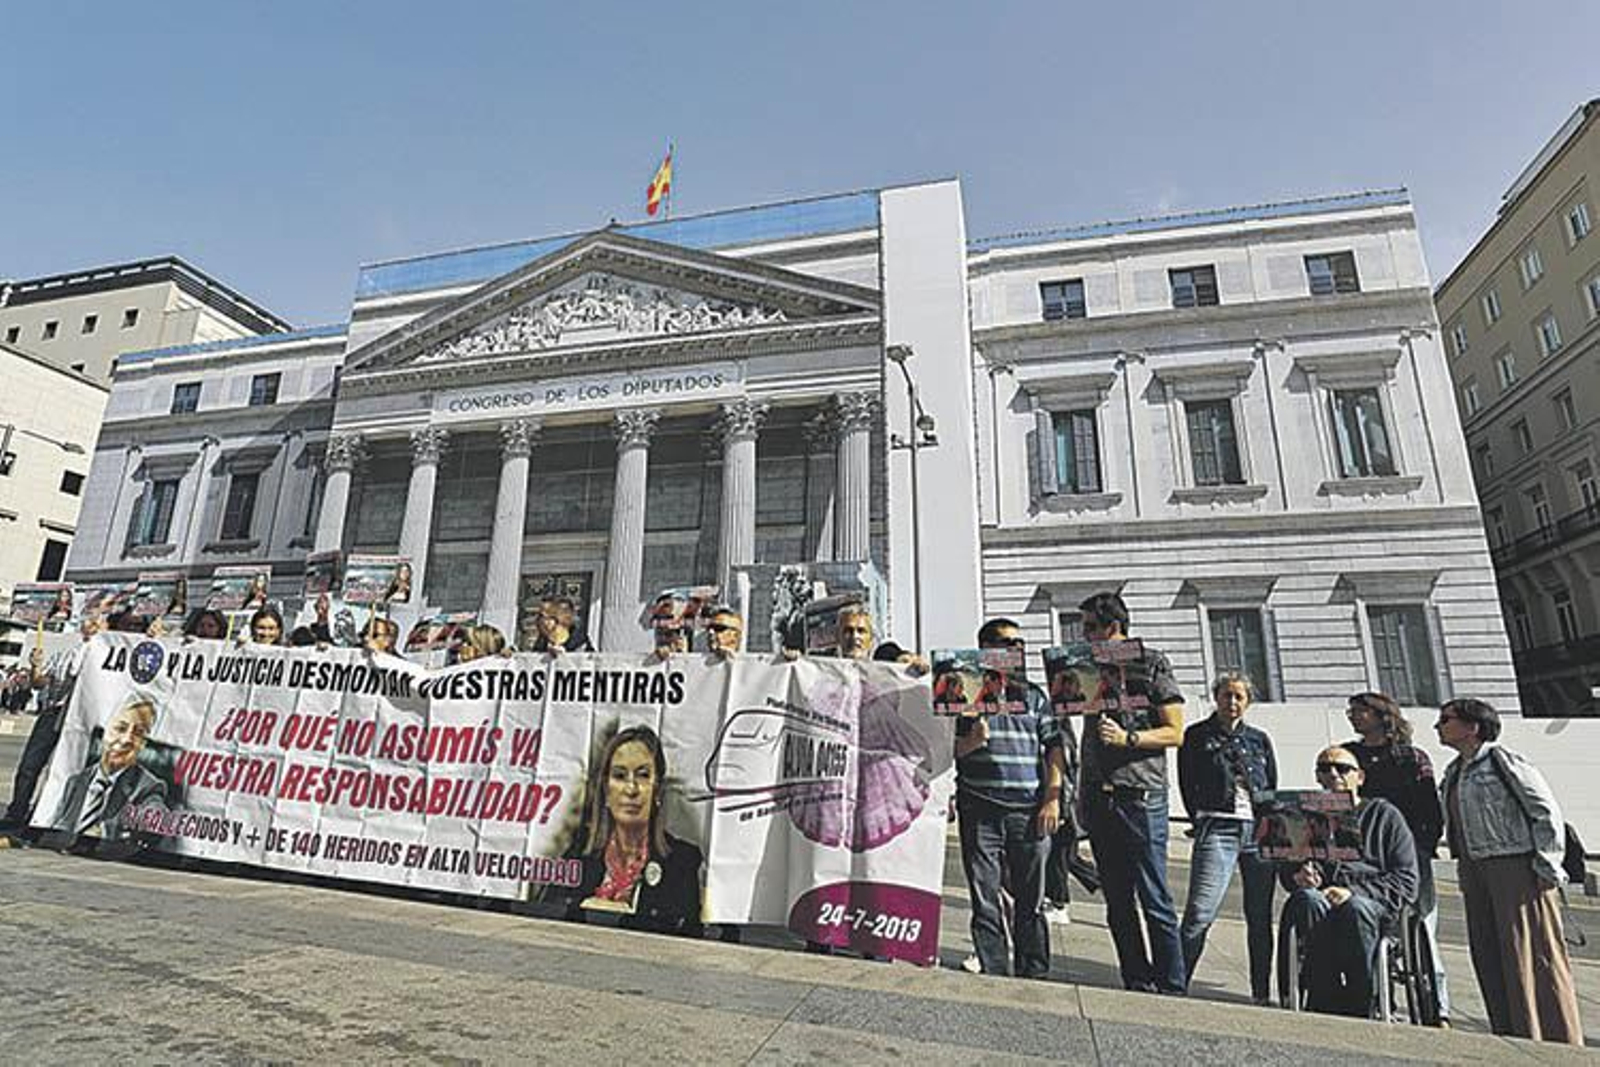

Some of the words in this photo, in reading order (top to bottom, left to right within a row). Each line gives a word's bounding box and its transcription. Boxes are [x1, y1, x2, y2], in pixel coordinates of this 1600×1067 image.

[449, 391, 534, 412] CONGRESO
[545, 388, 567, 402] DE
[577, 383, 610, 401] LOS
[622, 372, 724, 396] DIPUTADOS
[101, 646, 127, 672] LA
[167, 652, 180, 677] Y
[181, 652, 205, 681] LA
[208, 656, 284, 687] JUSTICIA
[552, 670, 685, 704] MENTIRAS
[214, 707, 278, 746] ¿POR
[278, 710, 339, 751] QUÉ
[337, 718, 377, 758] NO
[378, 719, 504, 765] ASUMÍS
[509, 727, 543, 768] YA
[173, 750, 279, 797] VUESTRA
[278, 763, 562, 824] RESPONSABILIDAD?
[142, 805, 228, 843] FALLECIDOS
[231, 818, 243, 845] Y
[246, 827, 261, 848] +
[265, 828, 288, 854] DE
[291, 831, 321, 857] 140
[323, 834, 403, 866] HERIDOS
[403, 843, 429, 869] EN
[428, 846, 470, 874] ALTA
[474, 851, 583, 887] VELOCIDAD
[817, 902, 922, 942] 24-7-2013
